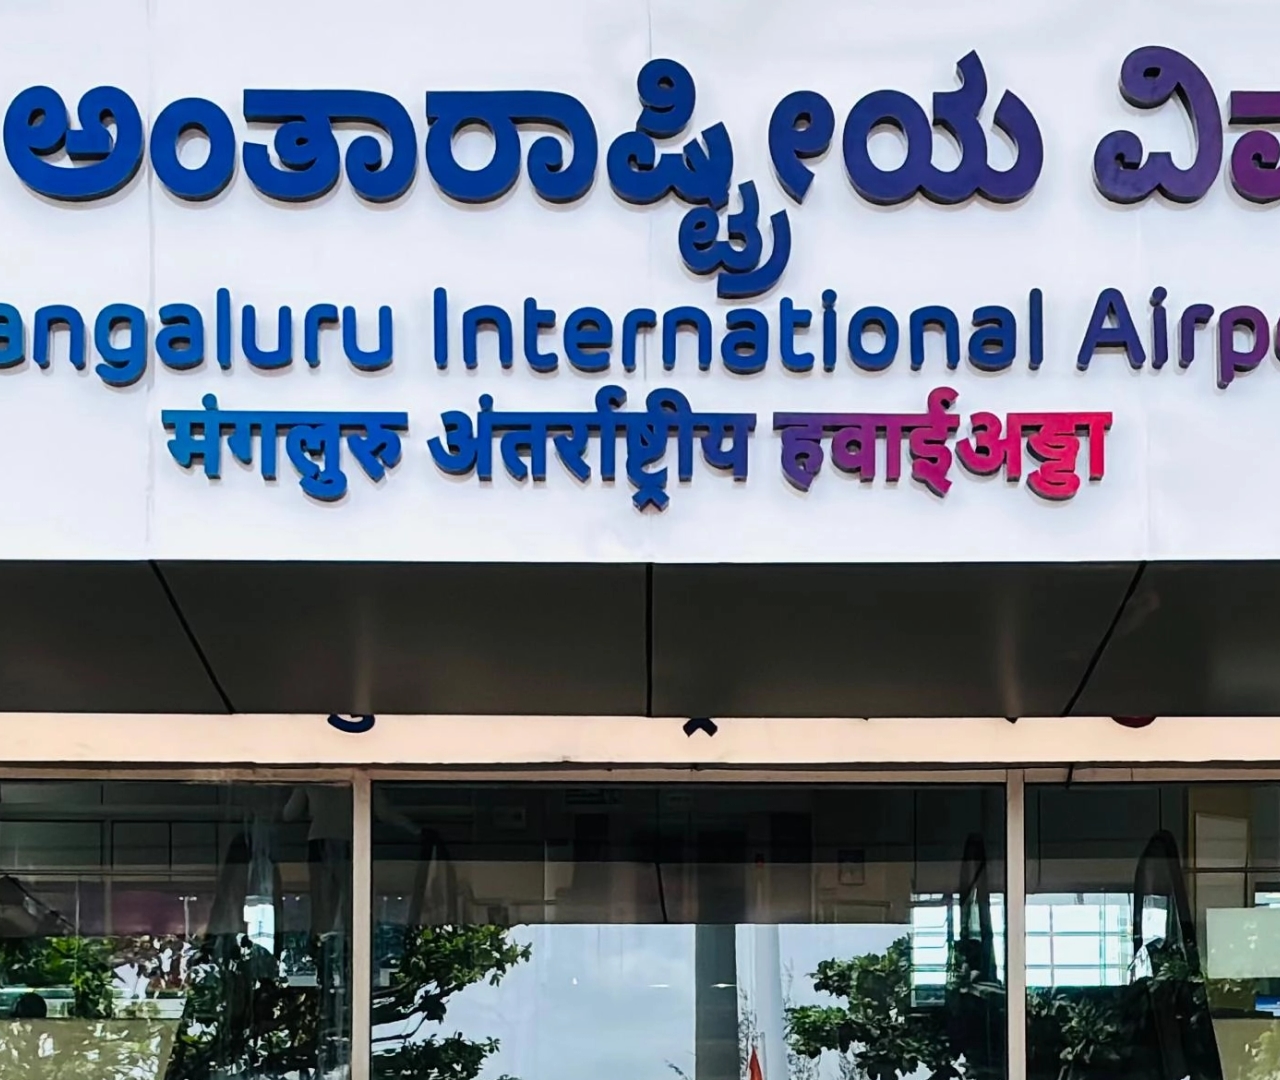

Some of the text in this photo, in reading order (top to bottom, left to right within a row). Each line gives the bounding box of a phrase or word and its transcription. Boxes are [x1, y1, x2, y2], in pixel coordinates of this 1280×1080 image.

[3, 50, 1043, 299] ಅಂತಾರಾಷ್ಟ್ರೀಯ
[434, 287, 1043, 375] International
[161, 393, 408, 502] मंगलुरु
[427, 385, 756, 512] अंतर्राष्ट्रीय
